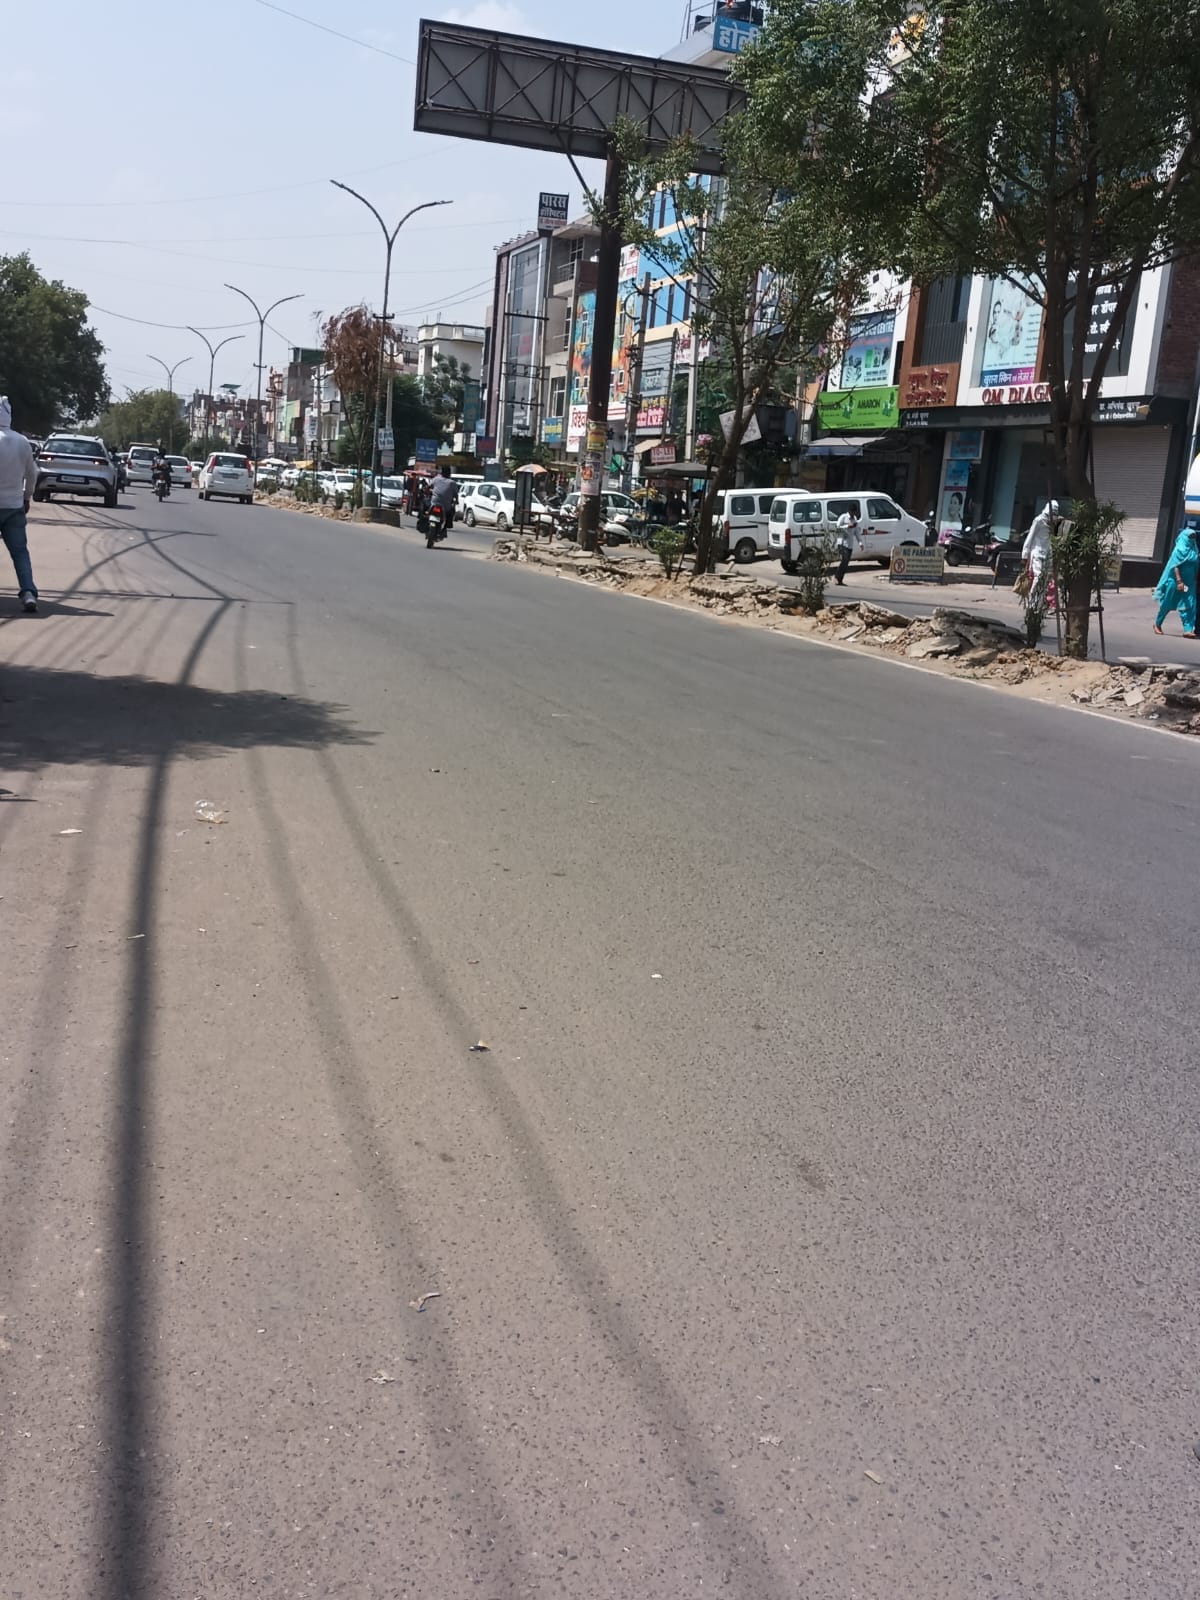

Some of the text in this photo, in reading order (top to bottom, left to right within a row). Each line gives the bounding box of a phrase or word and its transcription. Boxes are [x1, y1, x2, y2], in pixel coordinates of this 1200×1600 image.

[541, 194, 568, 208] पारस
[982, 388, 1004, 404] OM
[857, 399, 881, 408] AMARON
